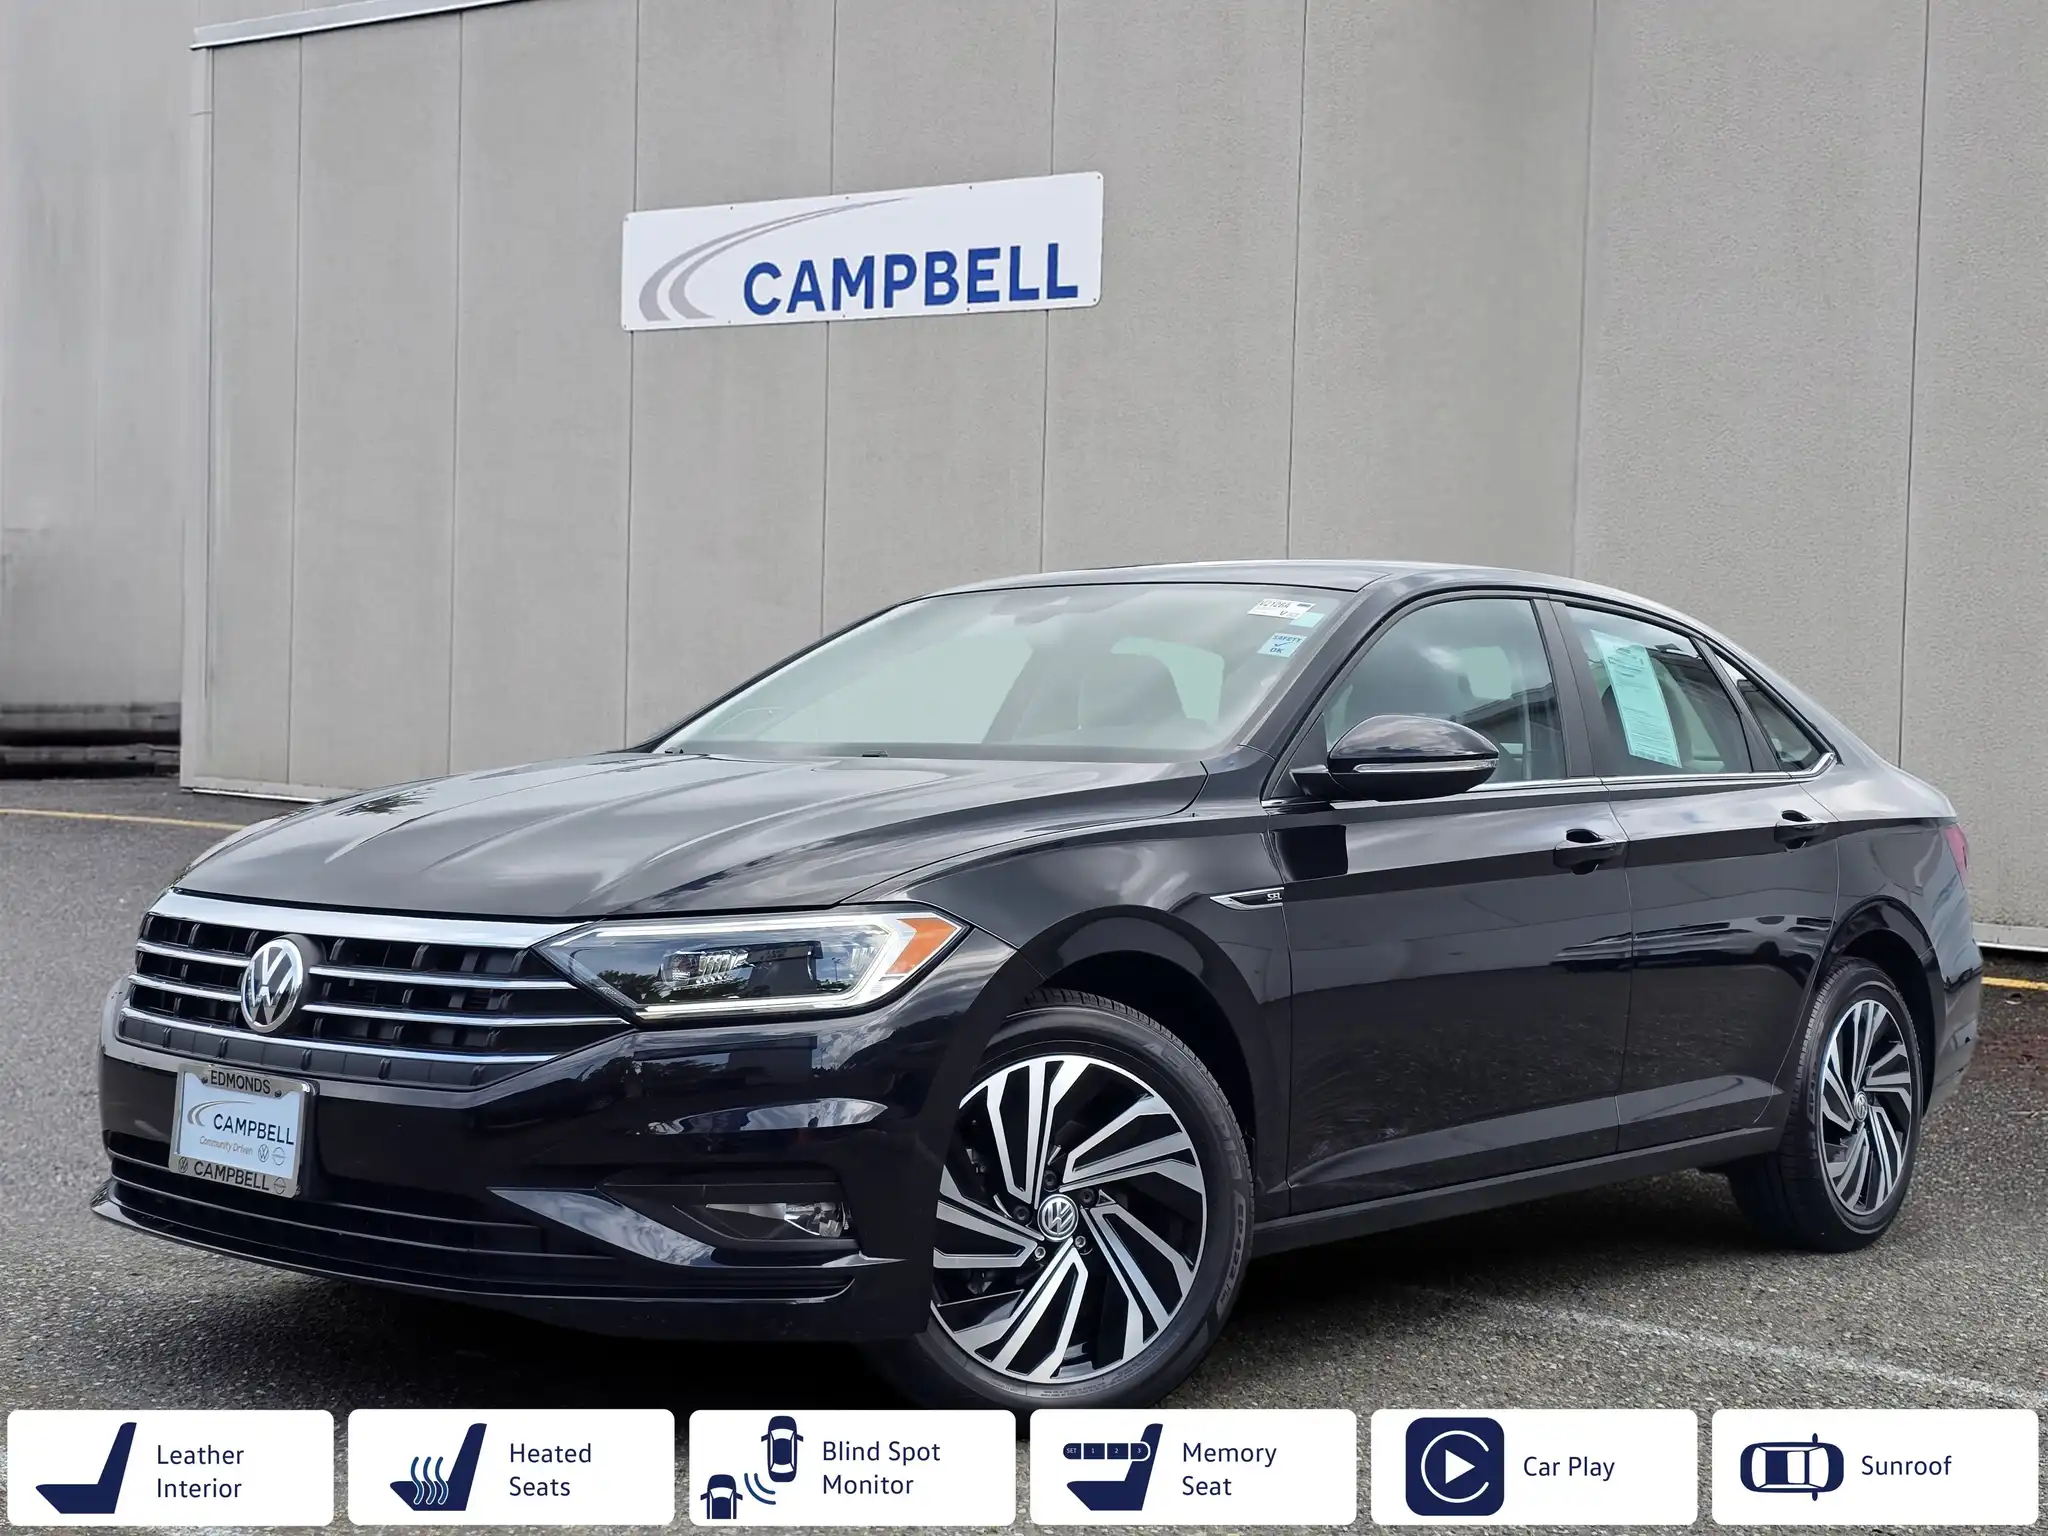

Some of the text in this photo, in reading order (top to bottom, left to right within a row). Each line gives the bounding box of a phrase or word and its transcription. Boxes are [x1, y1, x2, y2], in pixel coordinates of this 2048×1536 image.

[744, 243, 1078, 316] CAMPBELL
[1272, 635, 1303, 643] SAFETY
[1267, 892, 1283, 901] SEL
[210, 1070, 271, 1095] EDMONDS
[213, 1113, 295, 1146] CAMPBELL
[199, 1135, 253, 1155] Community Driven
[194, 1161, 270, 1191] CAMPBELL
